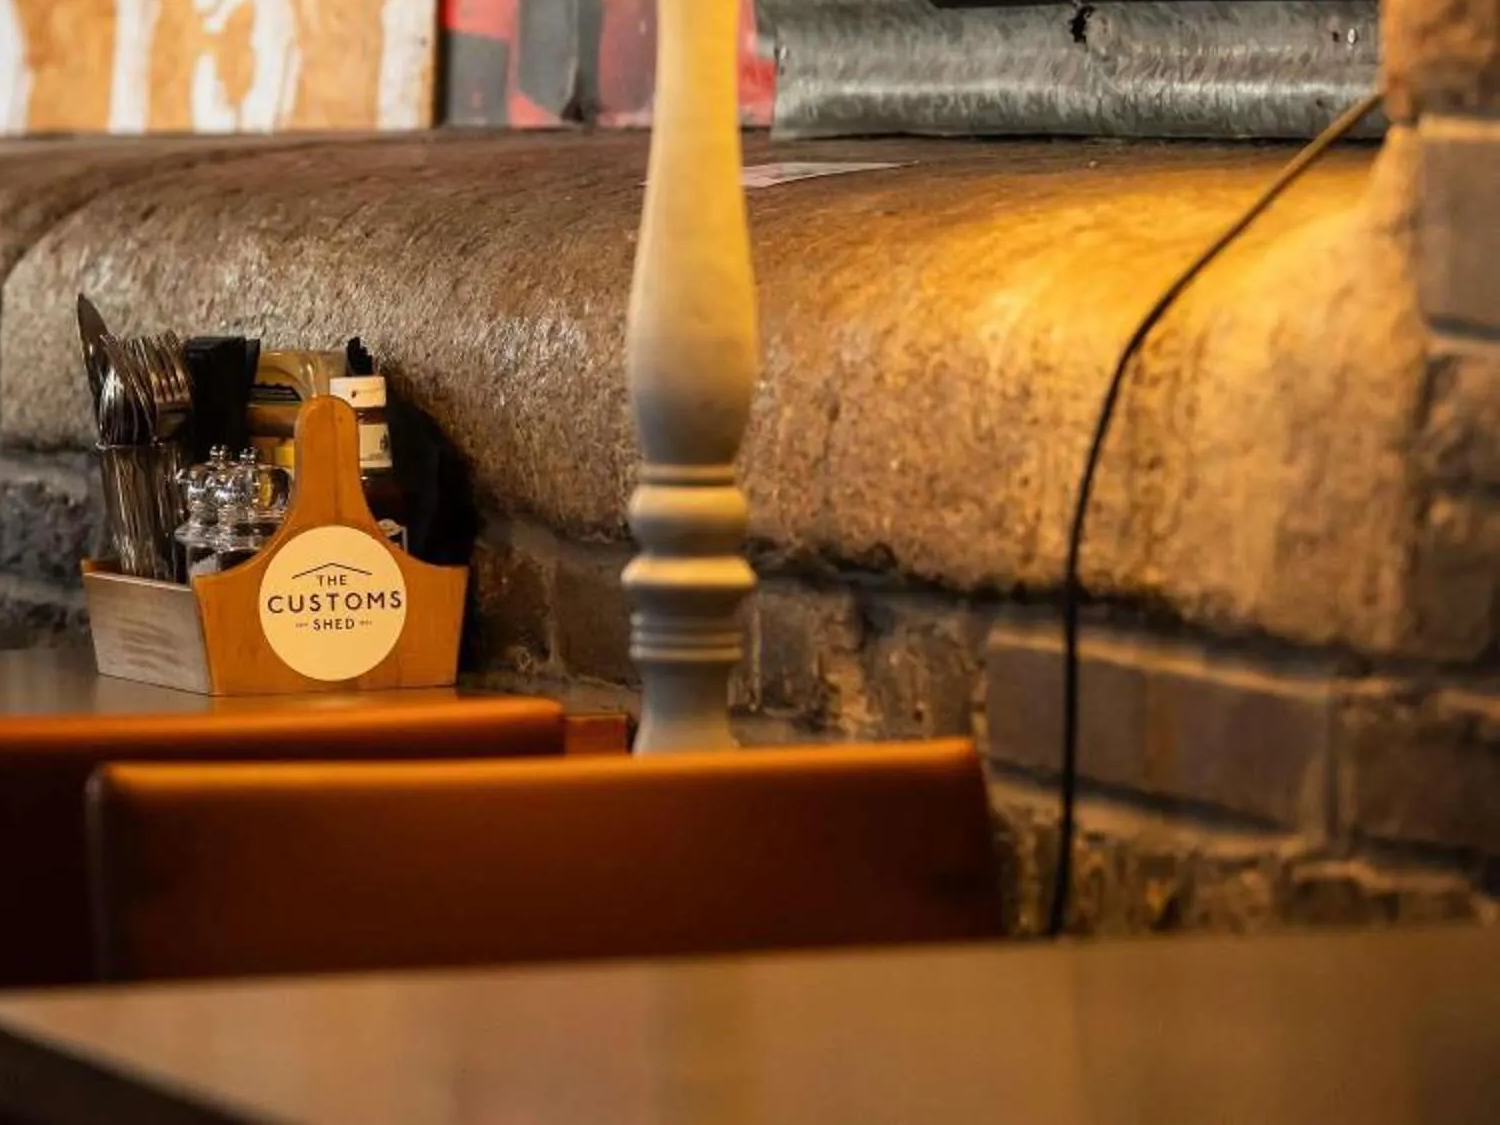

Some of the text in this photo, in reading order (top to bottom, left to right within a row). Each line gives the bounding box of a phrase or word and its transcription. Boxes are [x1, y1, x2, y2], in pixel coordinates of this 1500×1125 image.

[316, 574, 348, 587] THE
[267, 590, 402, 614] CUSTOMS
[313, 618, 355, 631] SHED
